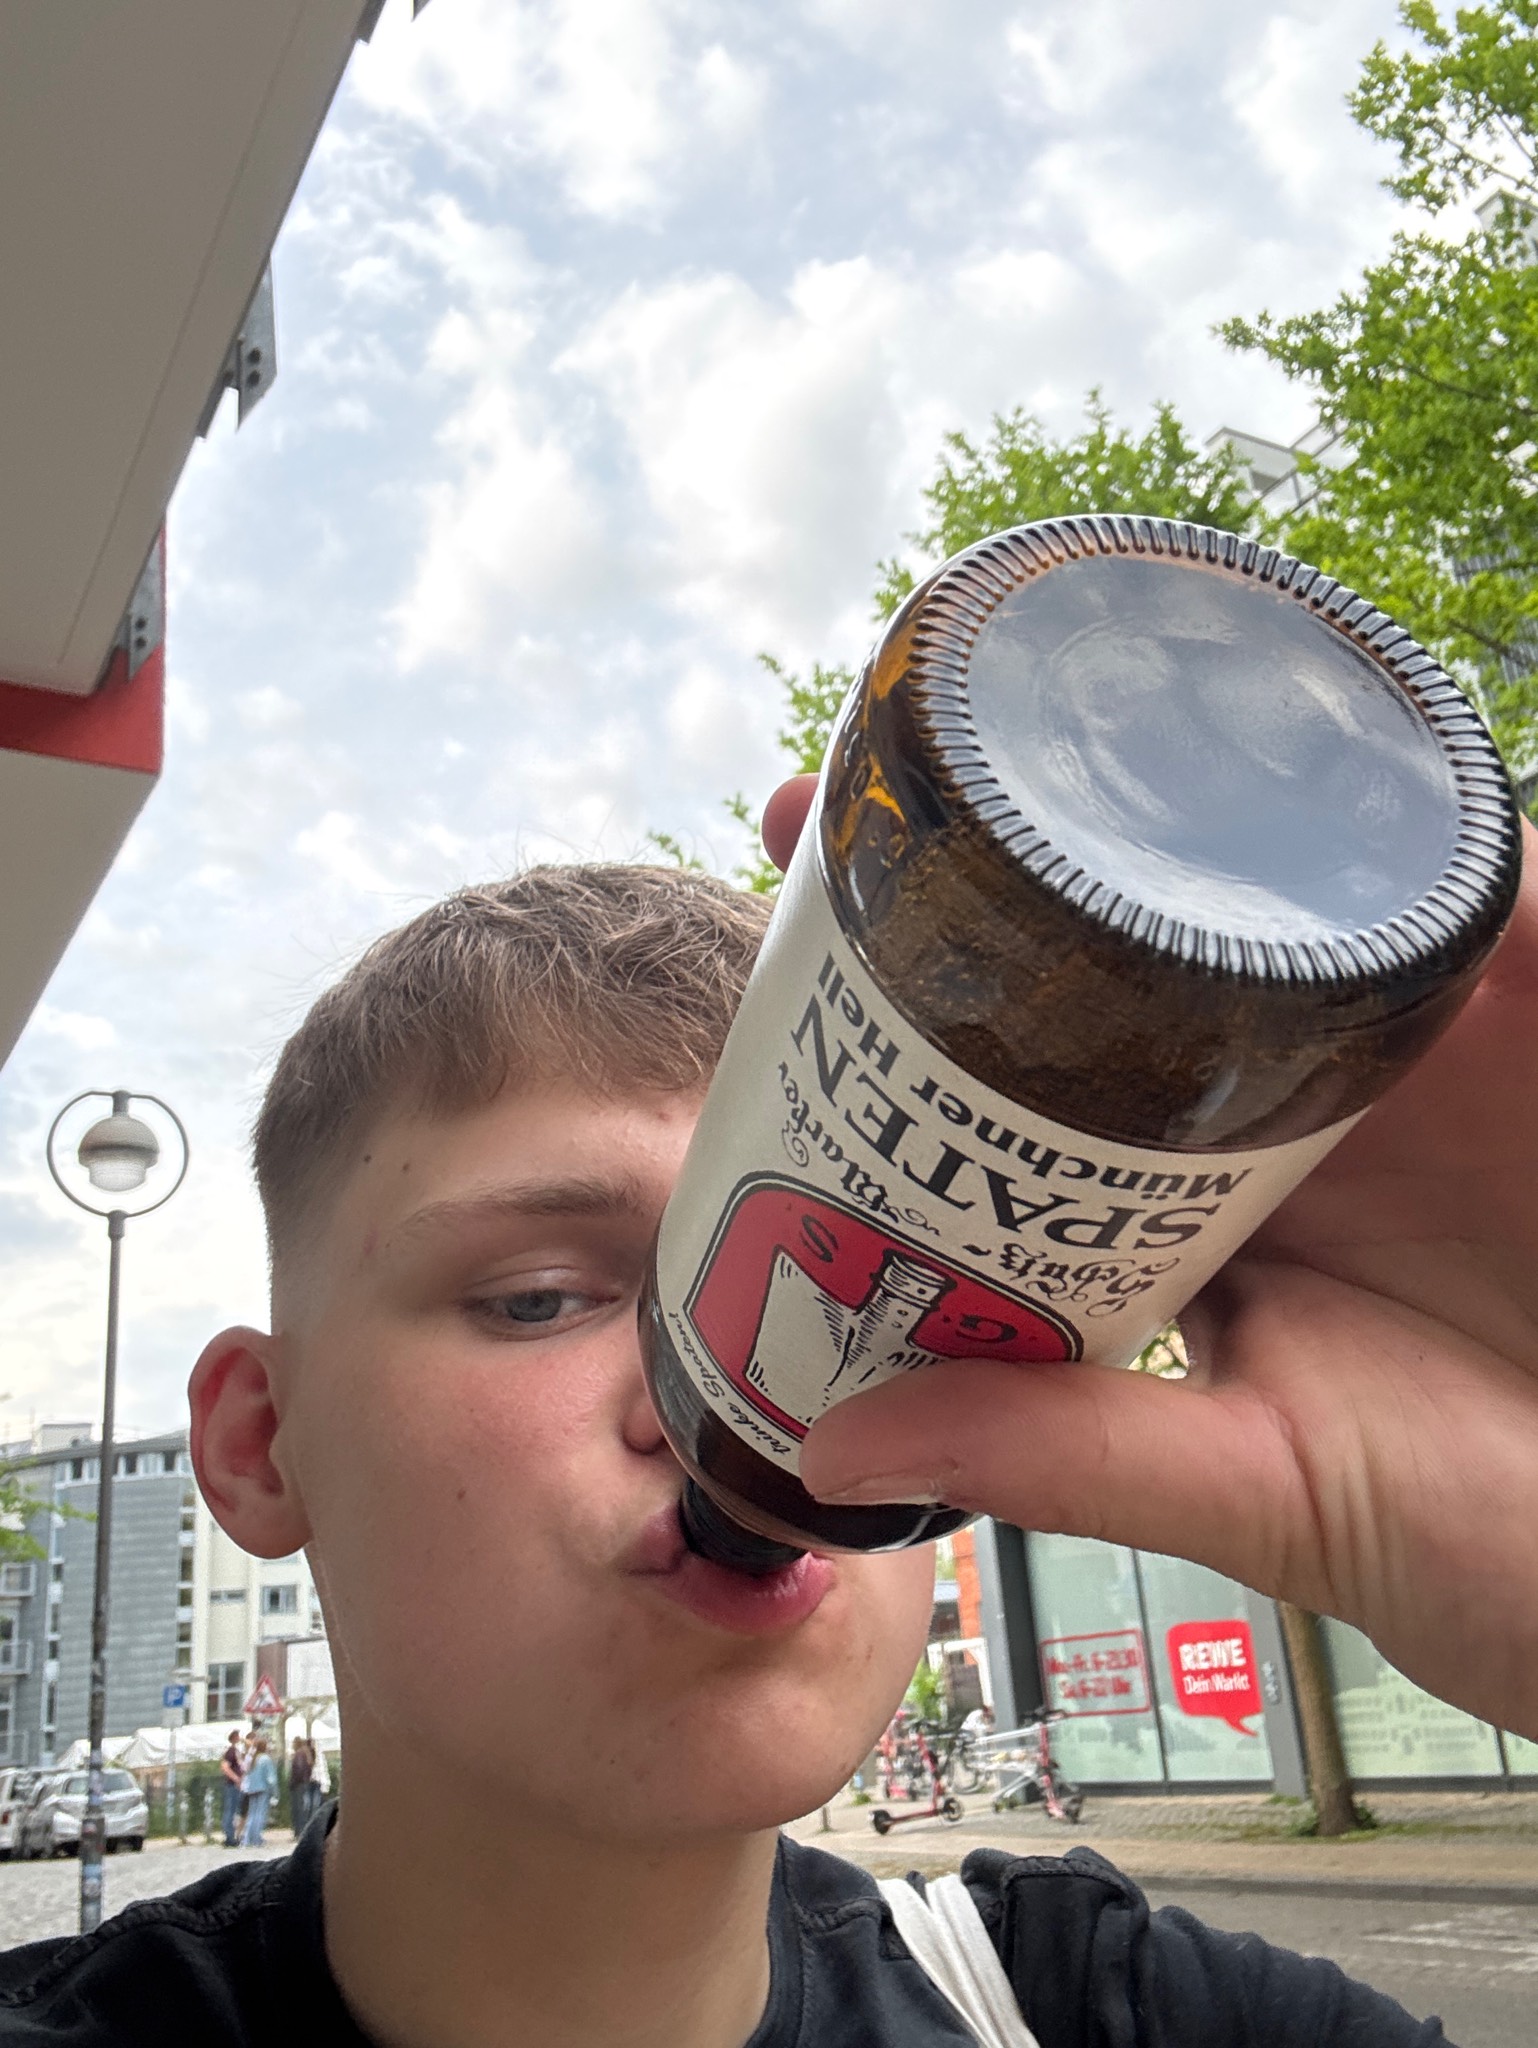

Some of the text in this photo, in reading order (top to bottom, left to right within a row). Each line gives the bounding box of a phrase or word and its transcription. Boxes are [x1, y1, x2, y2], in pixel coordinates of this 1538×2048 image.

[791, 992, 1222, 1250] SPATEN
[817, 951, 1253, 1200] Münchner Hell
[727, 1401, 792, 1455] trinke
[1178, 1638, 1247, 1672] REWE
